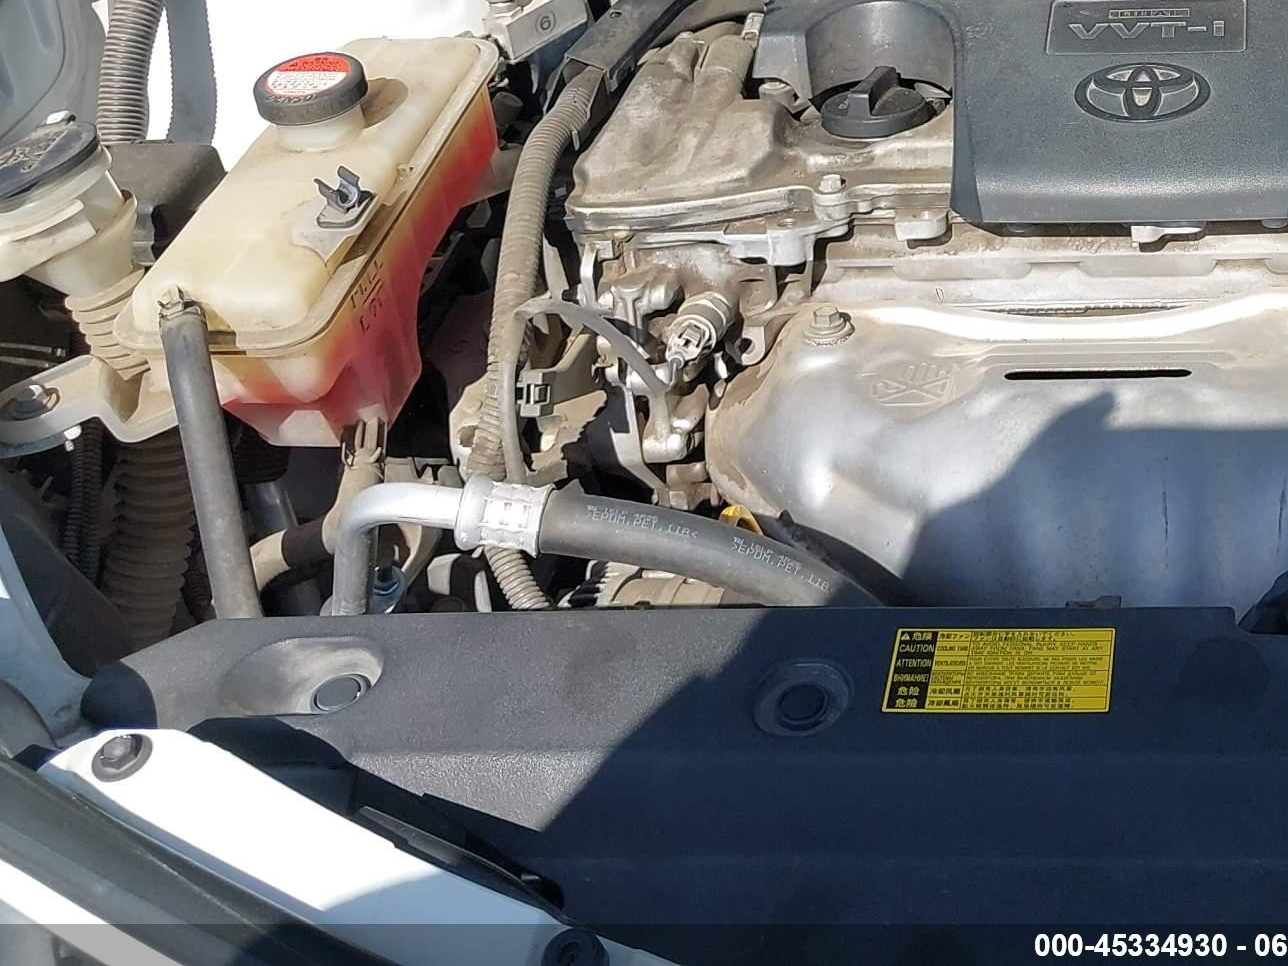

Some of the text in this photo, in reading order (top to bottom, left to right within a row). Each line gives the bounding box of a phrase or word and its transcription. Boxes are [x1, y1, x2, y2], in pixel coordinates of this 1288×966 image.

[1068, 20, 1225, 40] VVT-i
[899, 644, 935, 653] CAUTION
[896, 658, 932, 668] ATTENTION
